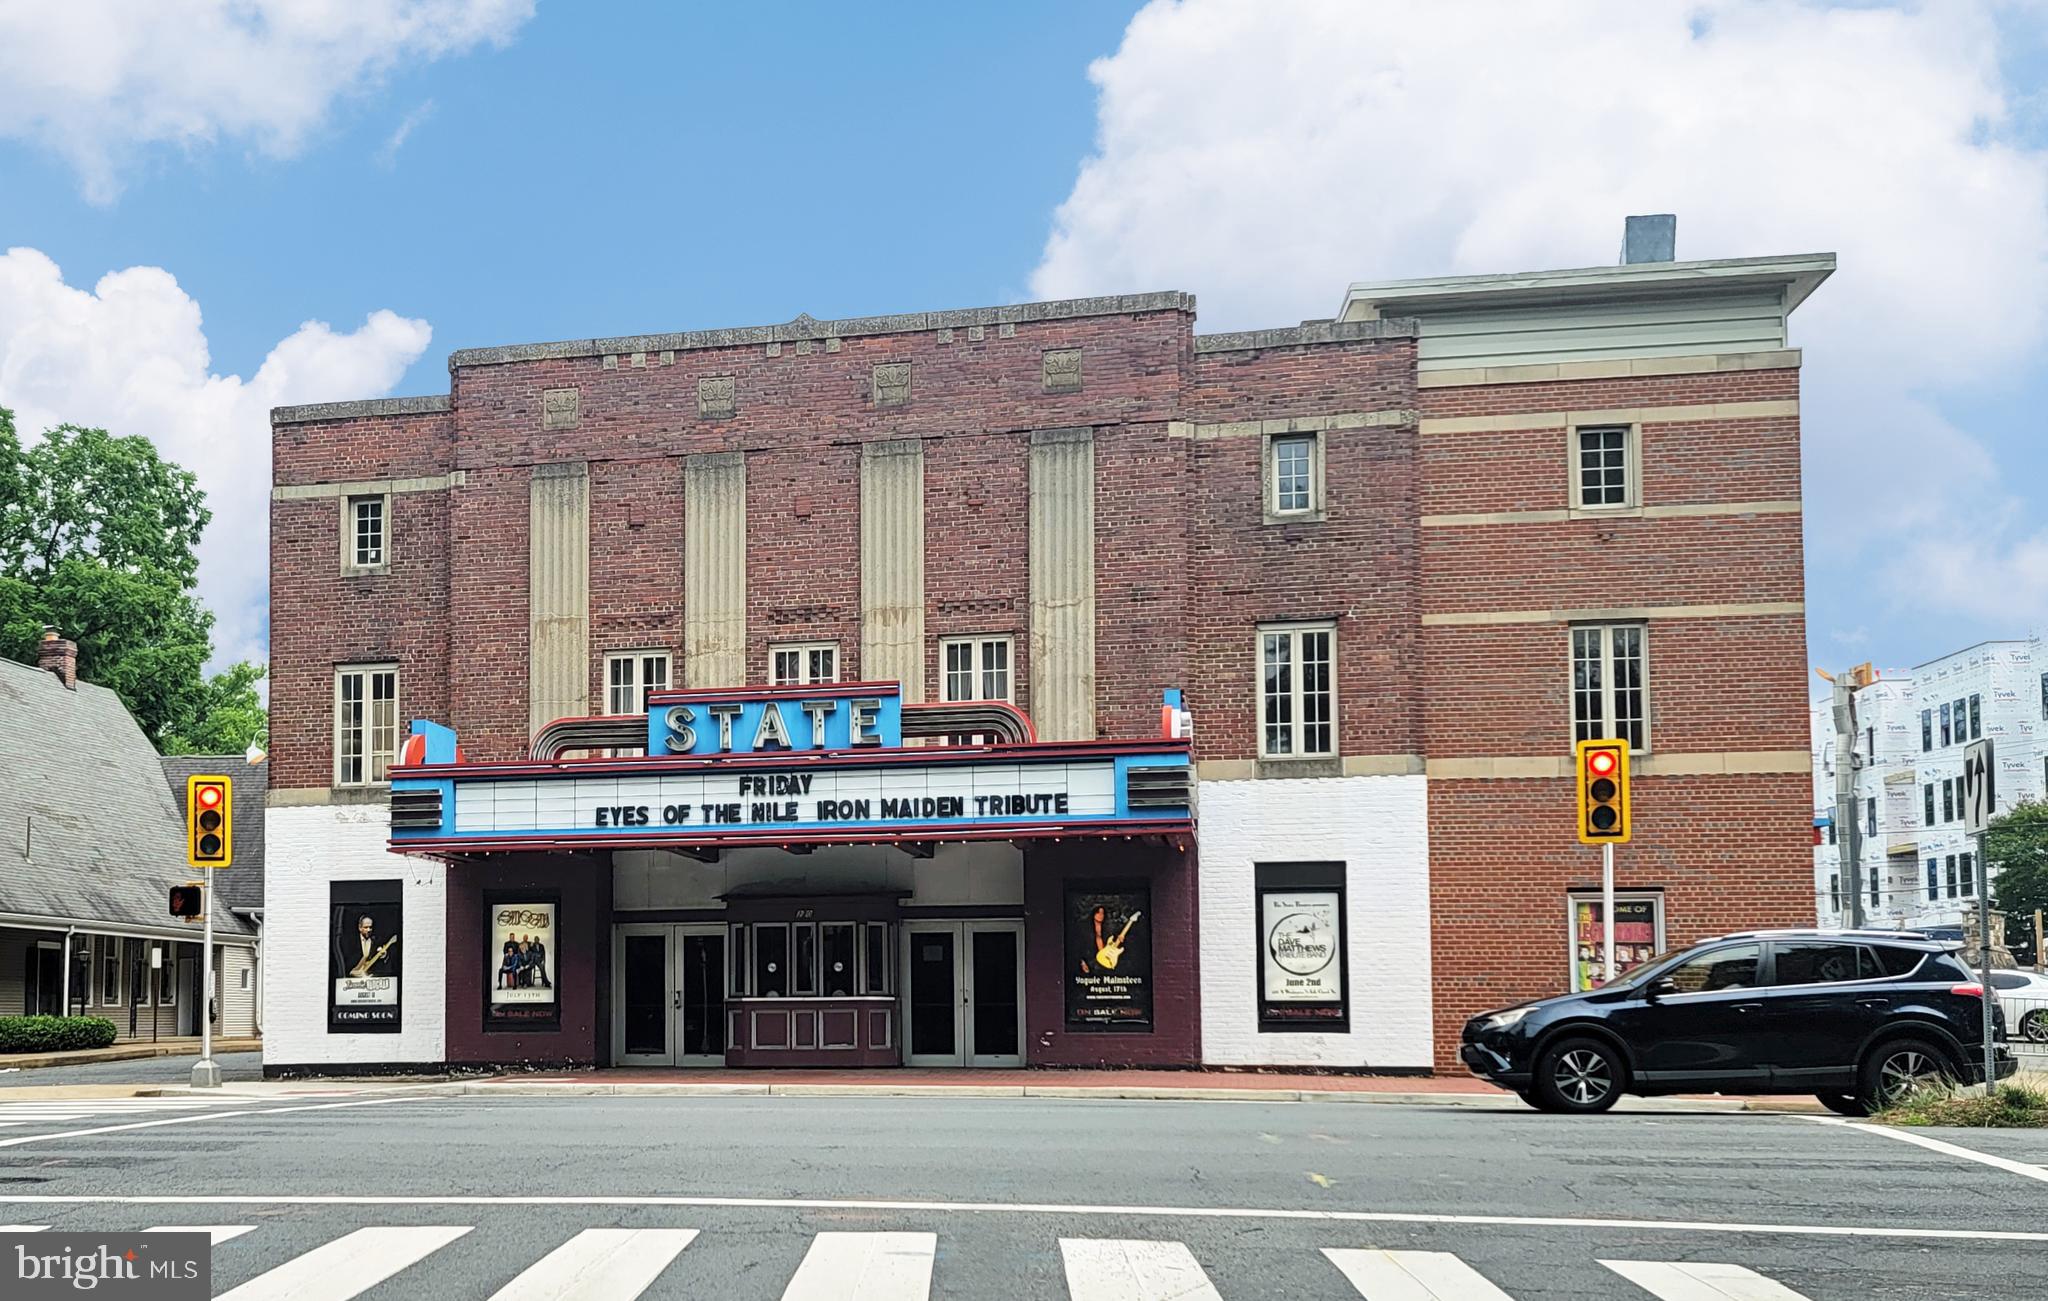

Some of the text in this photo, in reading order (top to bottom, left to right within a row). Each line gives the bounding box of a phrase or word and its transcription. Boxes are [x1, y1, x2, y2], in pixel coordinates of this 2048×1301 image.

[1994, 690, 2016, 698] Tyvek
[663, 698, 882, 753] STATE
[2002, 761, 2025, 770] Tyvek
[739, 774, 813, 797] FRIDAY
[596, 793, 1068, 827] EYES OF THE NILE IRON MAIDEN TRIBUTE
[1278, 944, 1327, 952] MATTHEWS
[1286, 978, 1321, 987] June 2nd
[338, 1011, 394, 1020] COMING SOON
